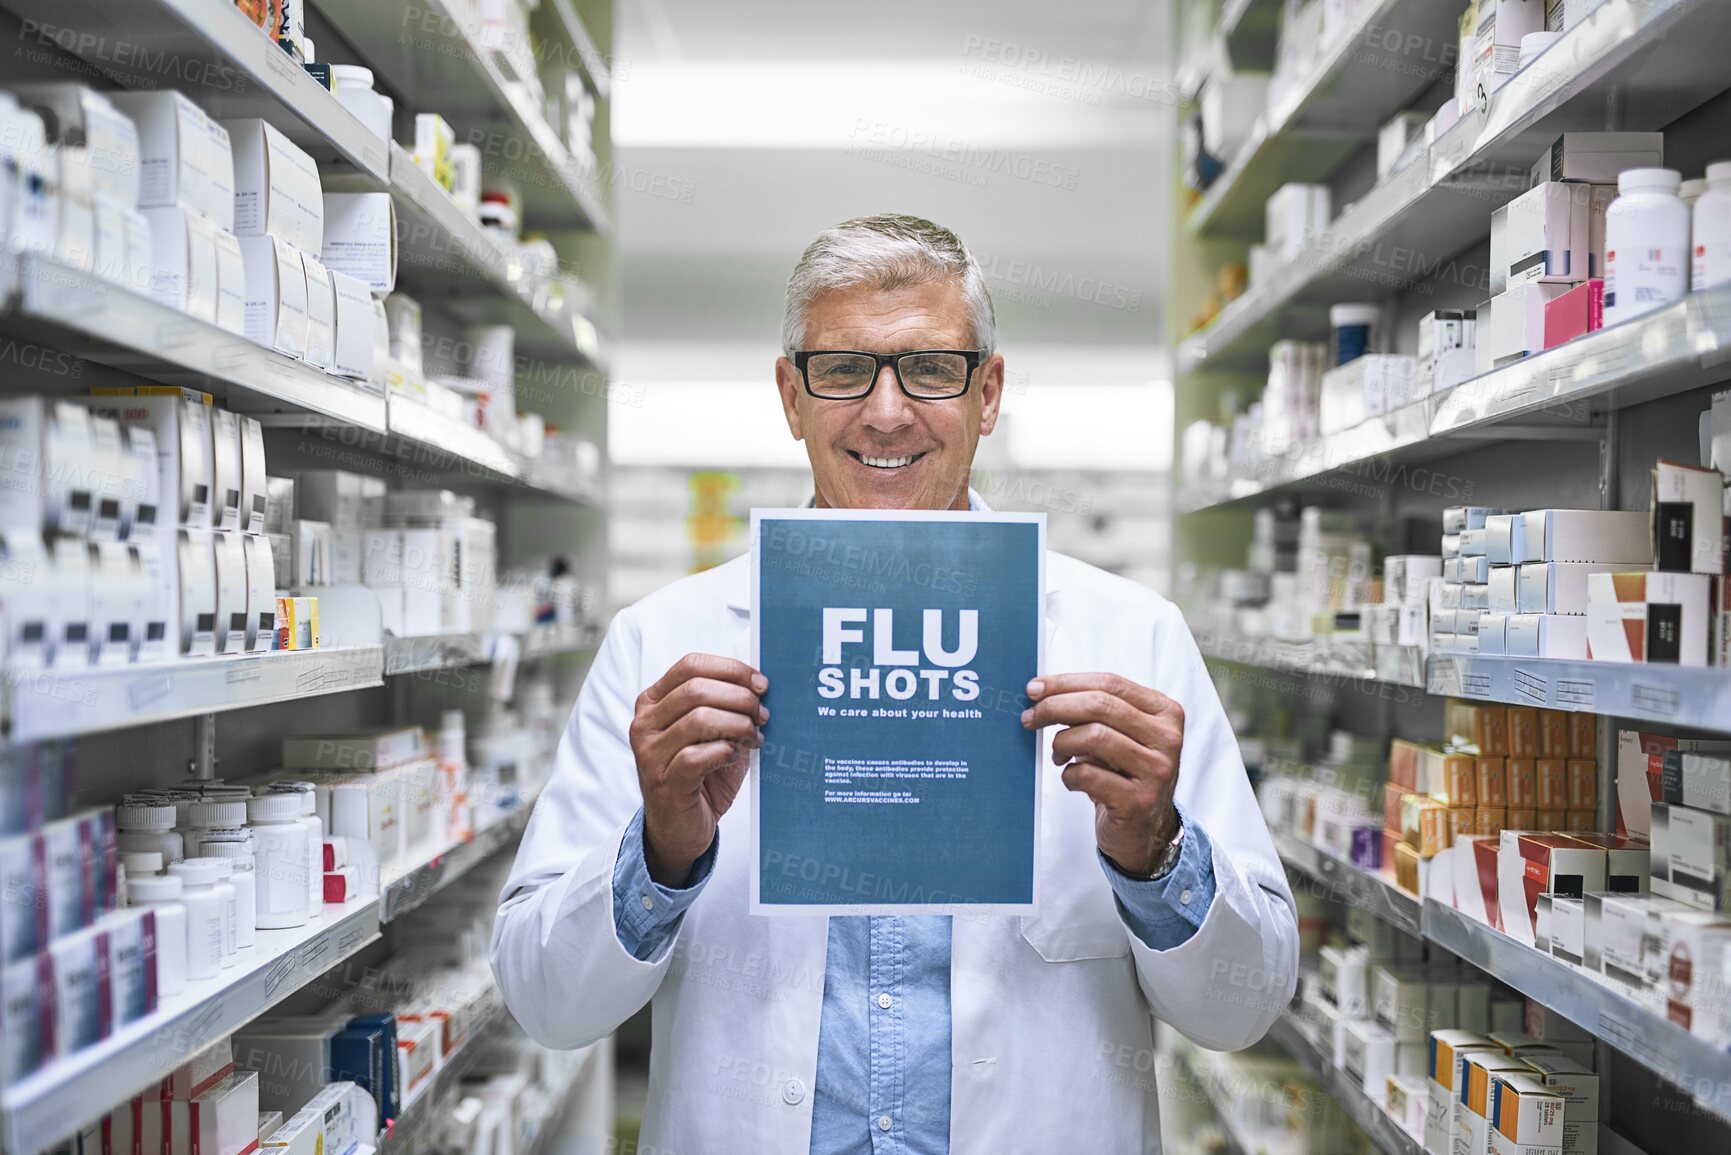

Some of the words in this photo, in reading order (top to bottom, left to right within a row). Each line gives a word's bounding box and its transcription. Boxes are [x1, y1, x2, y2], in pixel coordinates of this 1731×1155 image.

[822, 607, 979, 668] FLU
[817, 667, 980, 701] SHOTS
[817, 706, 836, 717] We
[840, 708, 868, 717] care
[872, 707, 907, 718] about
[911, 708, 939, 720] your
[942, 708, 982, 719] health
